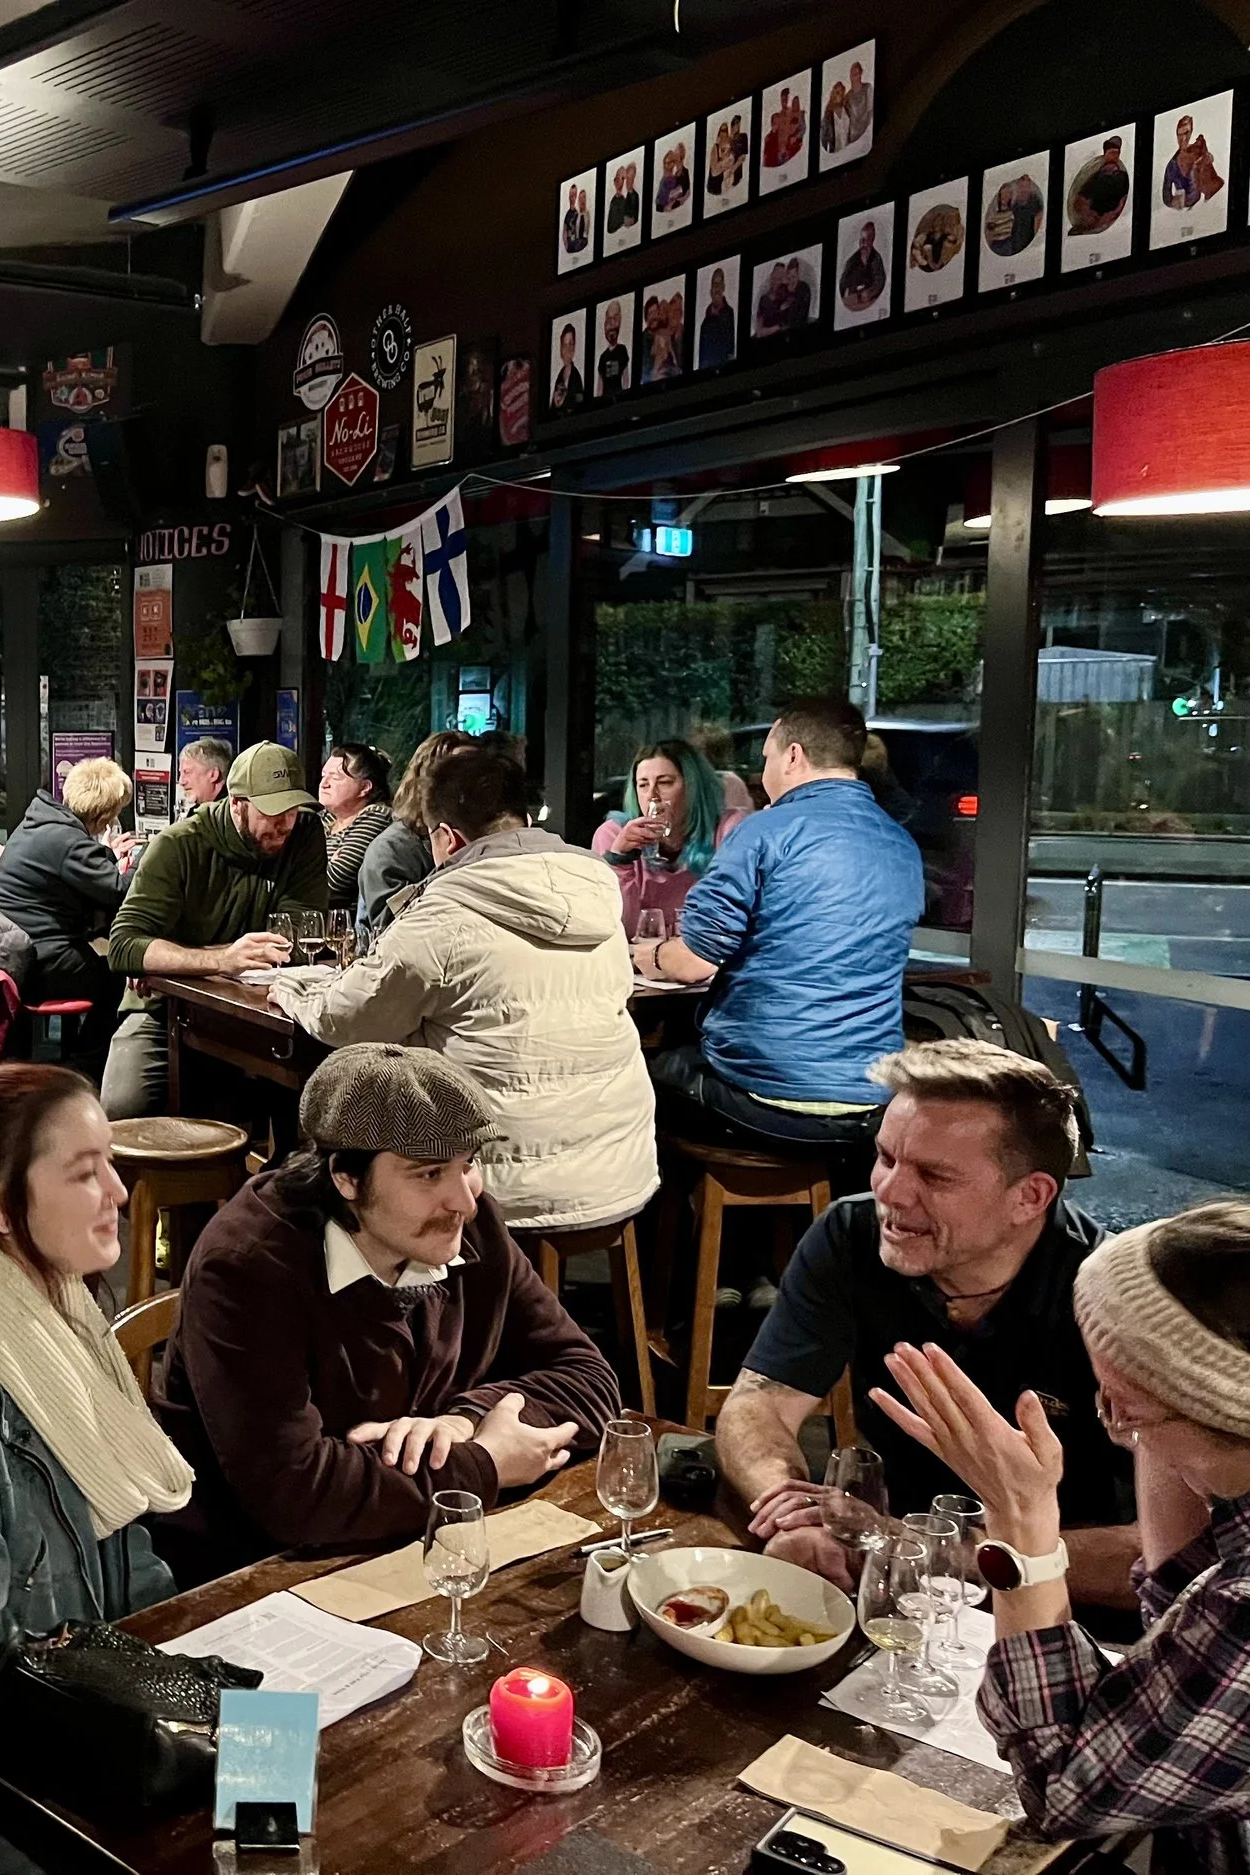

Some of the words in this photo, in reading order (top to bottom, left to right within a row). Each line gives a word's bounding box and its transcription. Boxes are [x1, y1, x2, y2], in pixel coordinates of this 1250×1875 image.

[370, 304, 393, 345] OTHER
[395, 303, 411, 334] HALF
[371, 362, 401, 390] BREWING
[329, 411, 373, 446] No-Li
